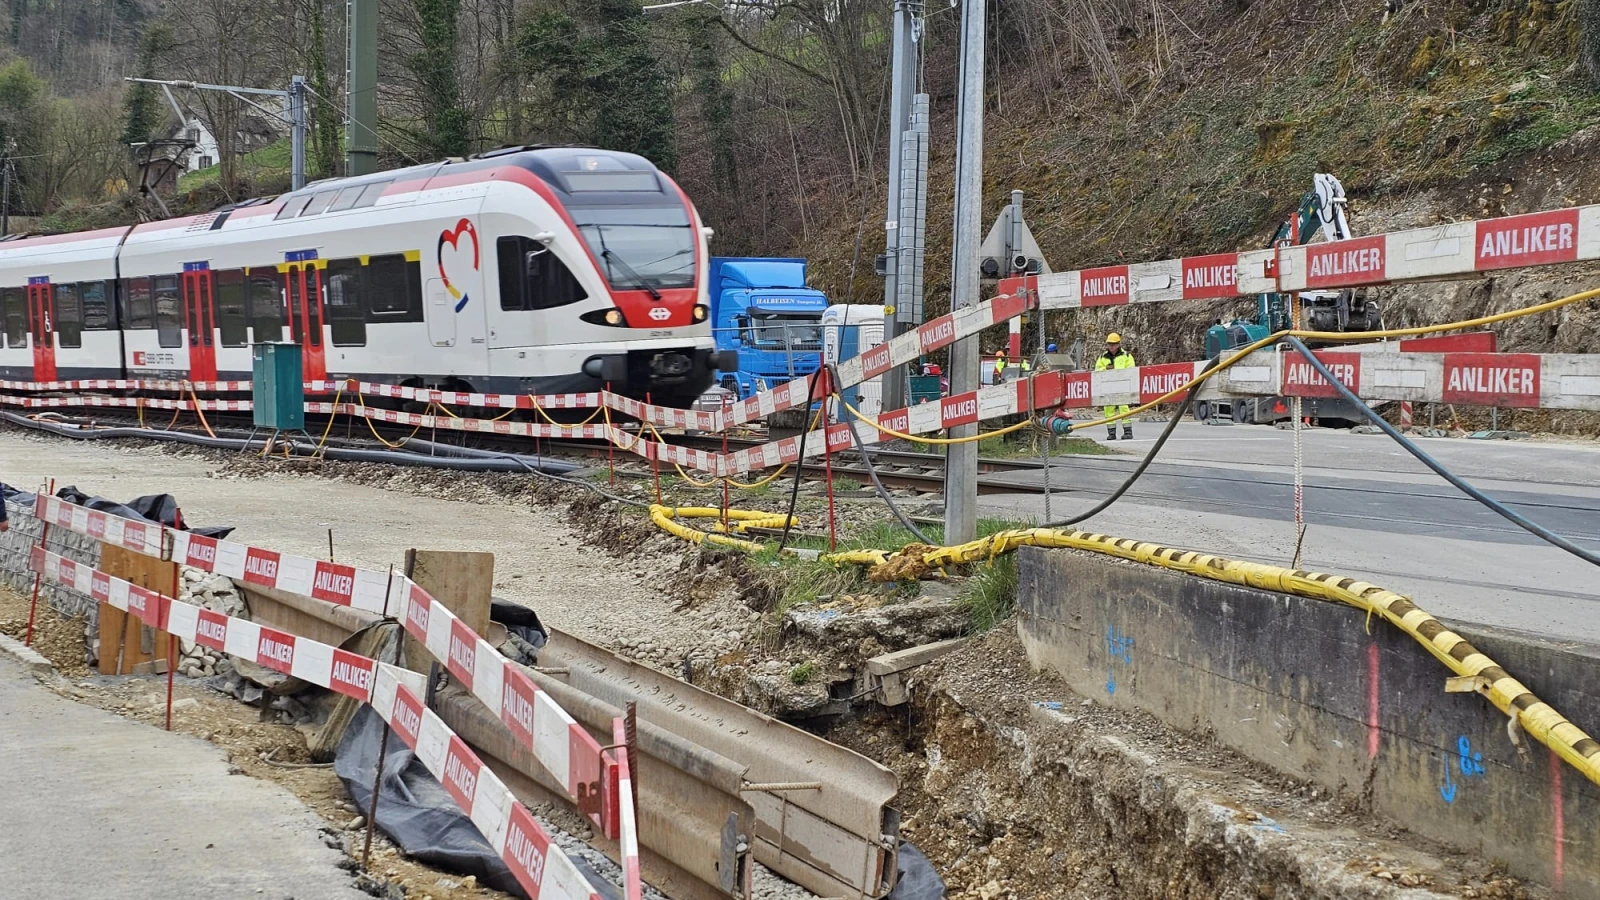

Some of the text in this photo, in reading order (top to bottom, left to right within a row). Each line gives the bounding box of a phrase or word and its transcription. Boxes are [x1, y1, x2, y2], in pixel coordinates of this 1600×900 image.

[1480, 223, 1573, 258] ANLIKER
[1310, 248, 1381, 277] ANLIKER
[1083, 276, 1127, 297] ANLIKER
[1186, 265, 1238, 288] ANLIKER
[921, 319, 954, 347] ANLIKER
[864, 350, 890, 373] ANLIKER
[1066, 382, 1089, 399] IKER
[1142, 373, 1190, 395] ANLIKER
[1448, 367, 1534, 393] ANLIKER
[943, 400, 976, 421] ANLIKER
[880, 416, 908, 434] ANLIKER
[188, 540, 215, 561] ANLIKER
[246, 555, 278, 577] ANLIKER
[315, 567, 352, 596] ANLIKER
[408, 599, 429, 632] ANLIKER
[197, 621, 226, 640] ANLIKER
[259, 638, 293, 664] ANLIKER
[449, 634, 475, 676] ANLIKER
[333, 661, 371, 690] ANLIKER
[394, 698, 419, 739] ANLIKER
[503, 683, 533, 735] ANLIKER
[445, 752, 477, 802] ANLIKER
[506, 822, 544, 887] ANLIKER
